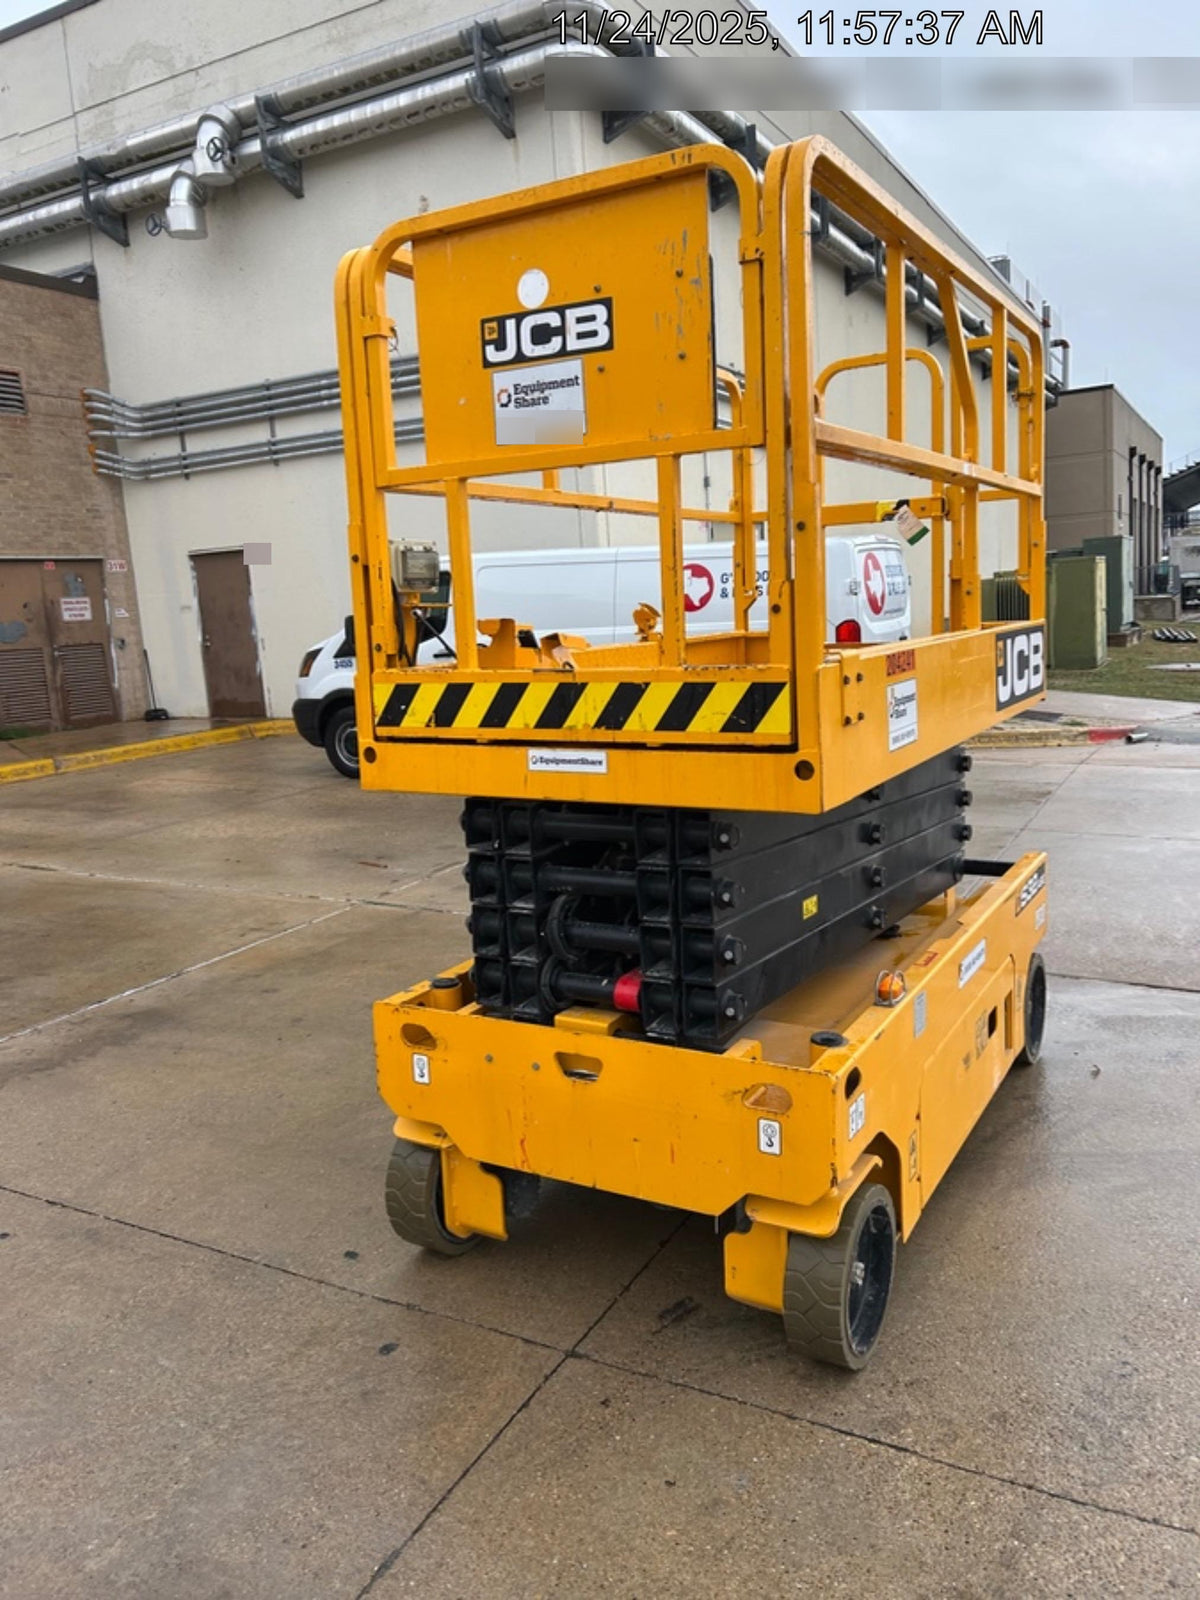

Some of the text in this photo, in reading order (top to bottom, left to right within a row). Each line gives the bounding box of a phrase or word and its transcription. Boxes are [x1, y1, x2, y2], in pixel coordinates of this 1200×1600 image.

[484, 303, 611, 363] JCB
[513, 374, 580, 396] Equipment
[513, 393, 550, 409] Share
[996, 631, 1044, 703] JCB
